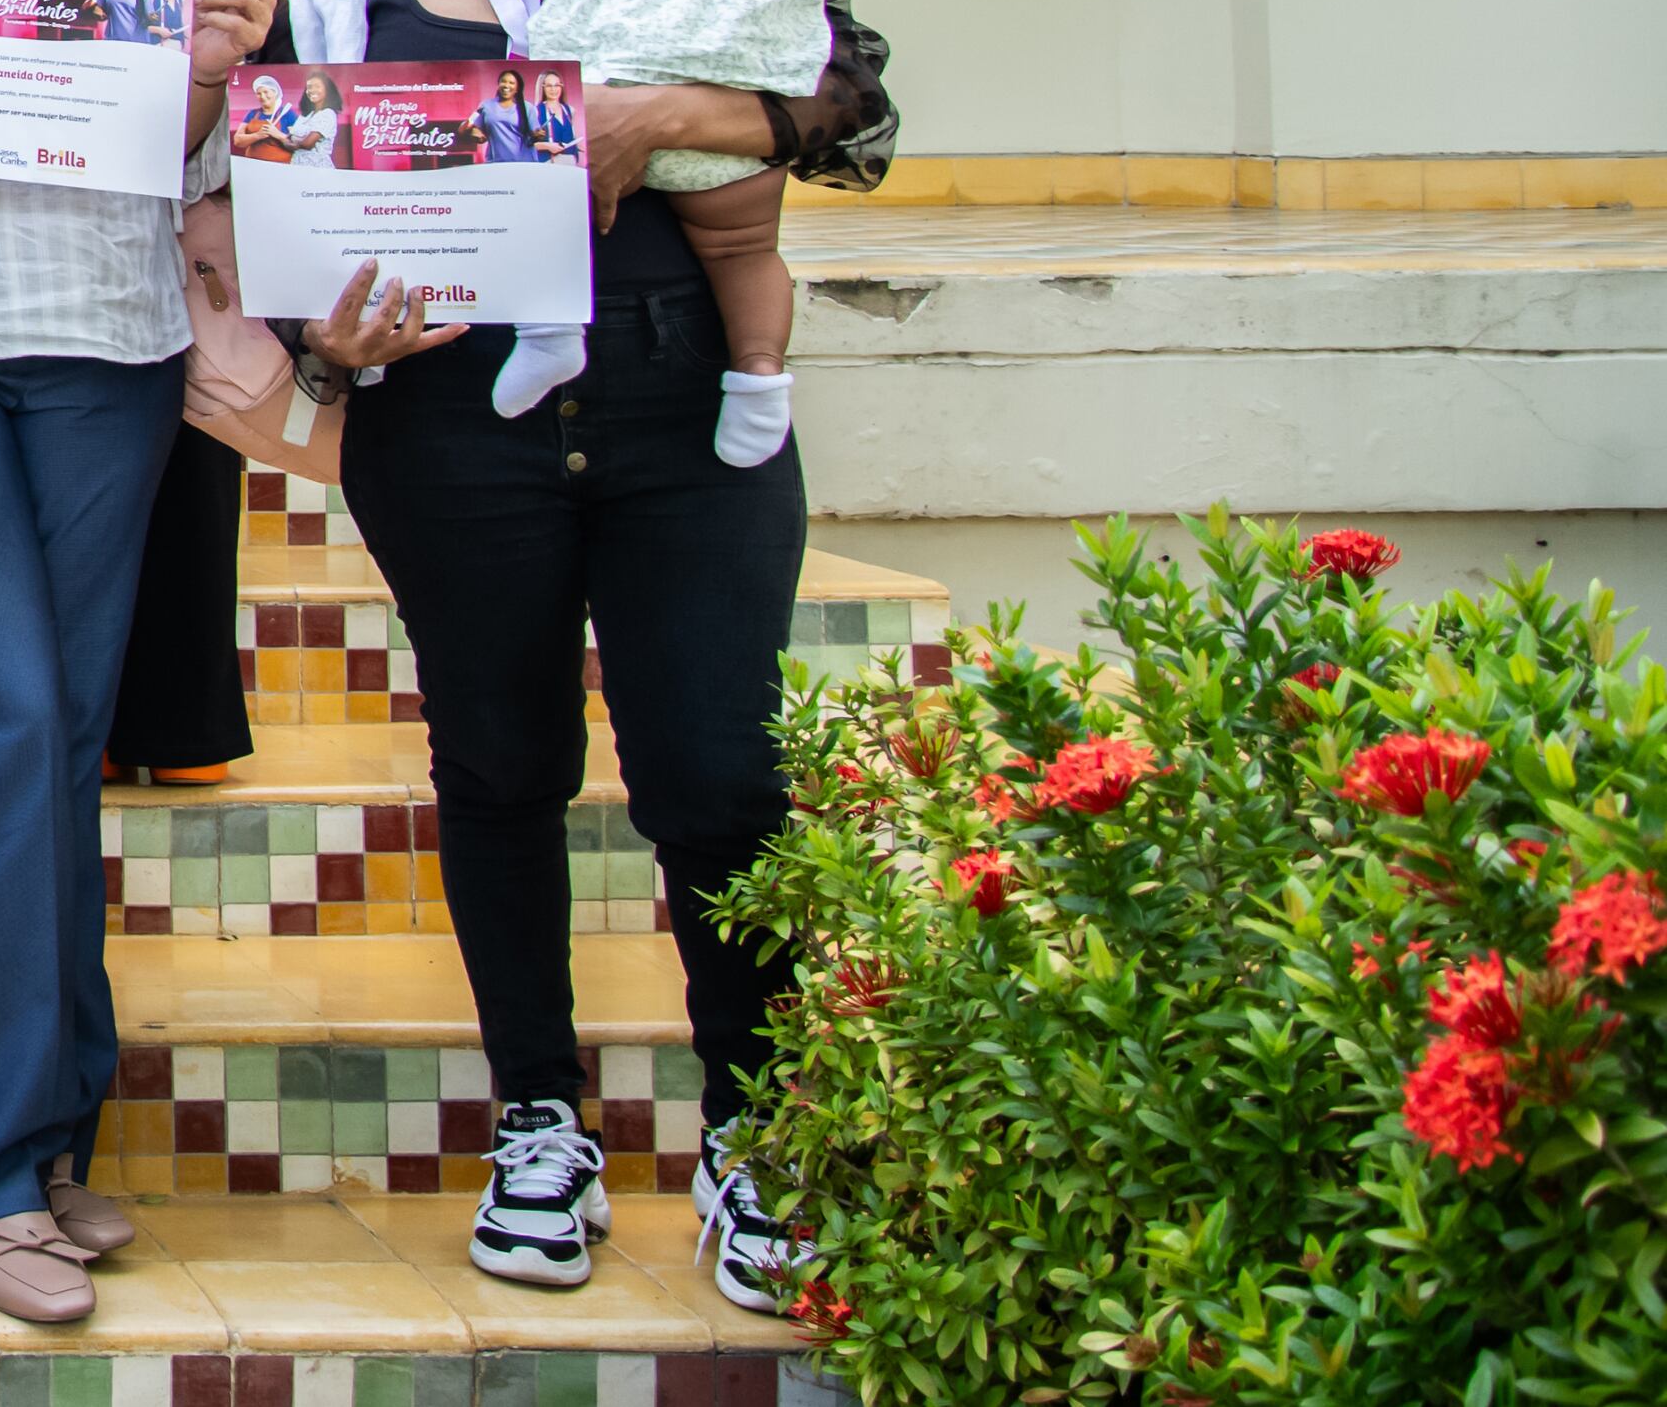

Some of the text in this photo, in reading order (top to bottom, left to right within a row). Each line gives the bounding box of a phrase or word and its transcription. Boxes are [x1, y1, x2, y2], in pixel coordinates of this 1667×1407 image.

[35, 71, 73, 86] Ortega
[378, 99, 418, 113] Premio
[354, 106, 427, 133] Mujeres
[362, 126, 455, 149] Brillantes
[0, 156, 28, 166] Caribe
[37, 149, 86, 167] Brilla
[363, 204, 453, 217] Katerin Campo
[421, 285, 476, 302] Brilla
